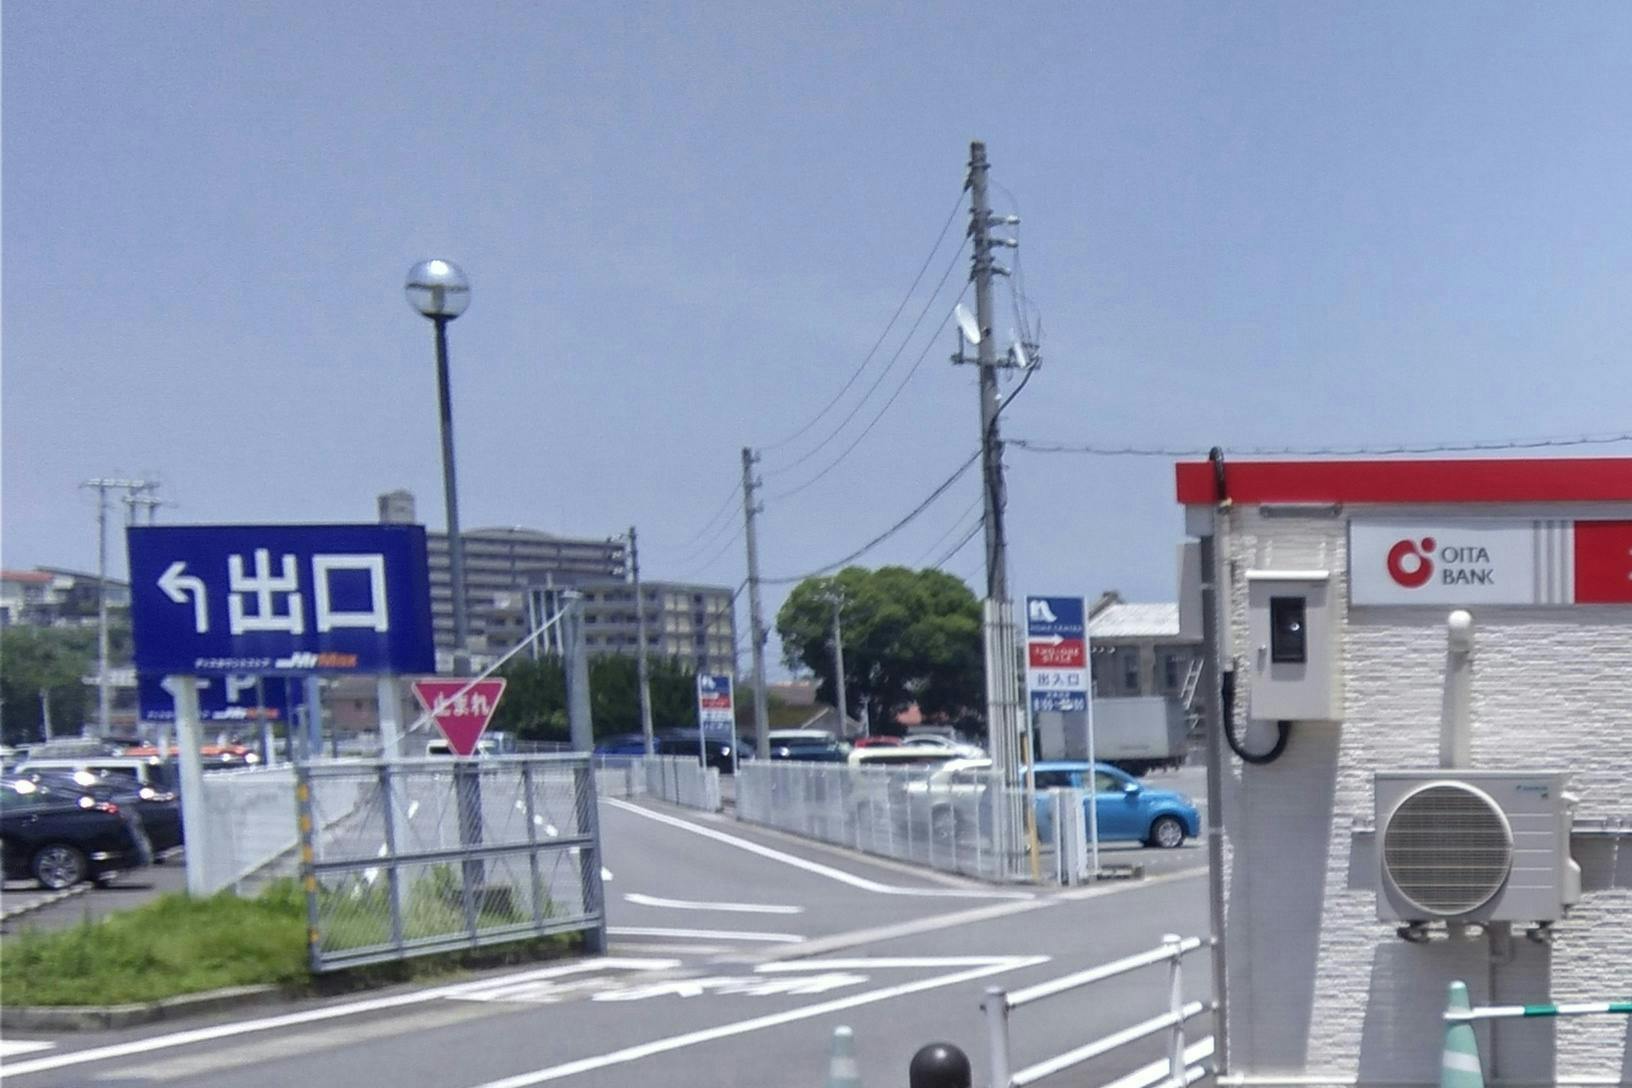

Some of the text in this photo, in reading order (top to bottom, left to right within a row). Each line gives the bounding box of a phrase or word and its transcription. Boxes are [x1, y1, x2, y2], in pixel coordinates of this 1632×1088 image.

[1441, 546, 1490, 564] OITA
[1442, 568, 1494, 586] BANK
[227, 547, 389, 636] 出口
[1038, 672, 1081, 686] 出入口
[433, 691, 490, 717] 止まれ
